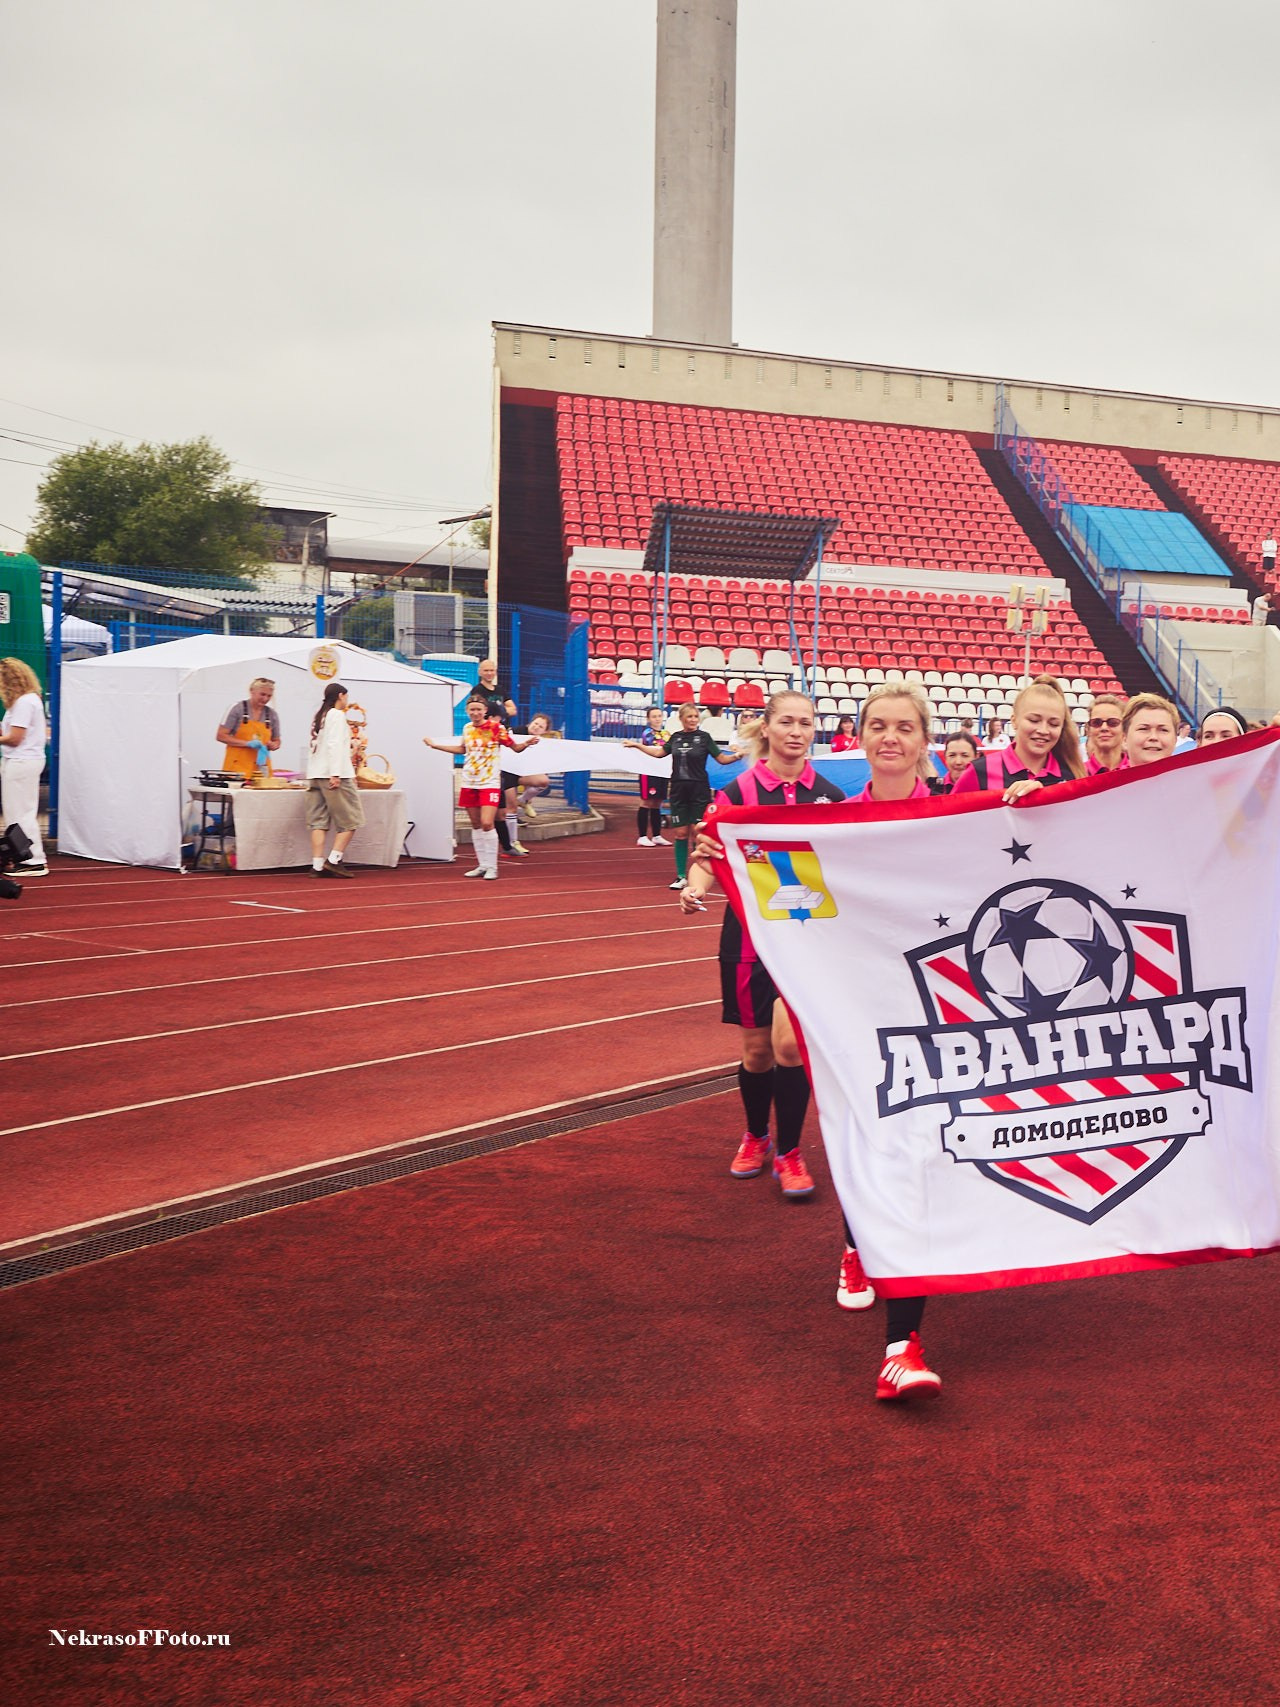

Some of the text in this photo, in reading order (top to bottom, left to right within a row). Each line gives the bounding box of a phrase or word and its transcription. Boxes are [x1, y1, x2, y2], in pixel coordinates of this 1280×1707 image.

[489, 792, 500, 803] 15
[886, 996, 1248, 1108] АВАНГАРД
[992, 1106, 1169, 1149] ДОМОДЕДОВО
